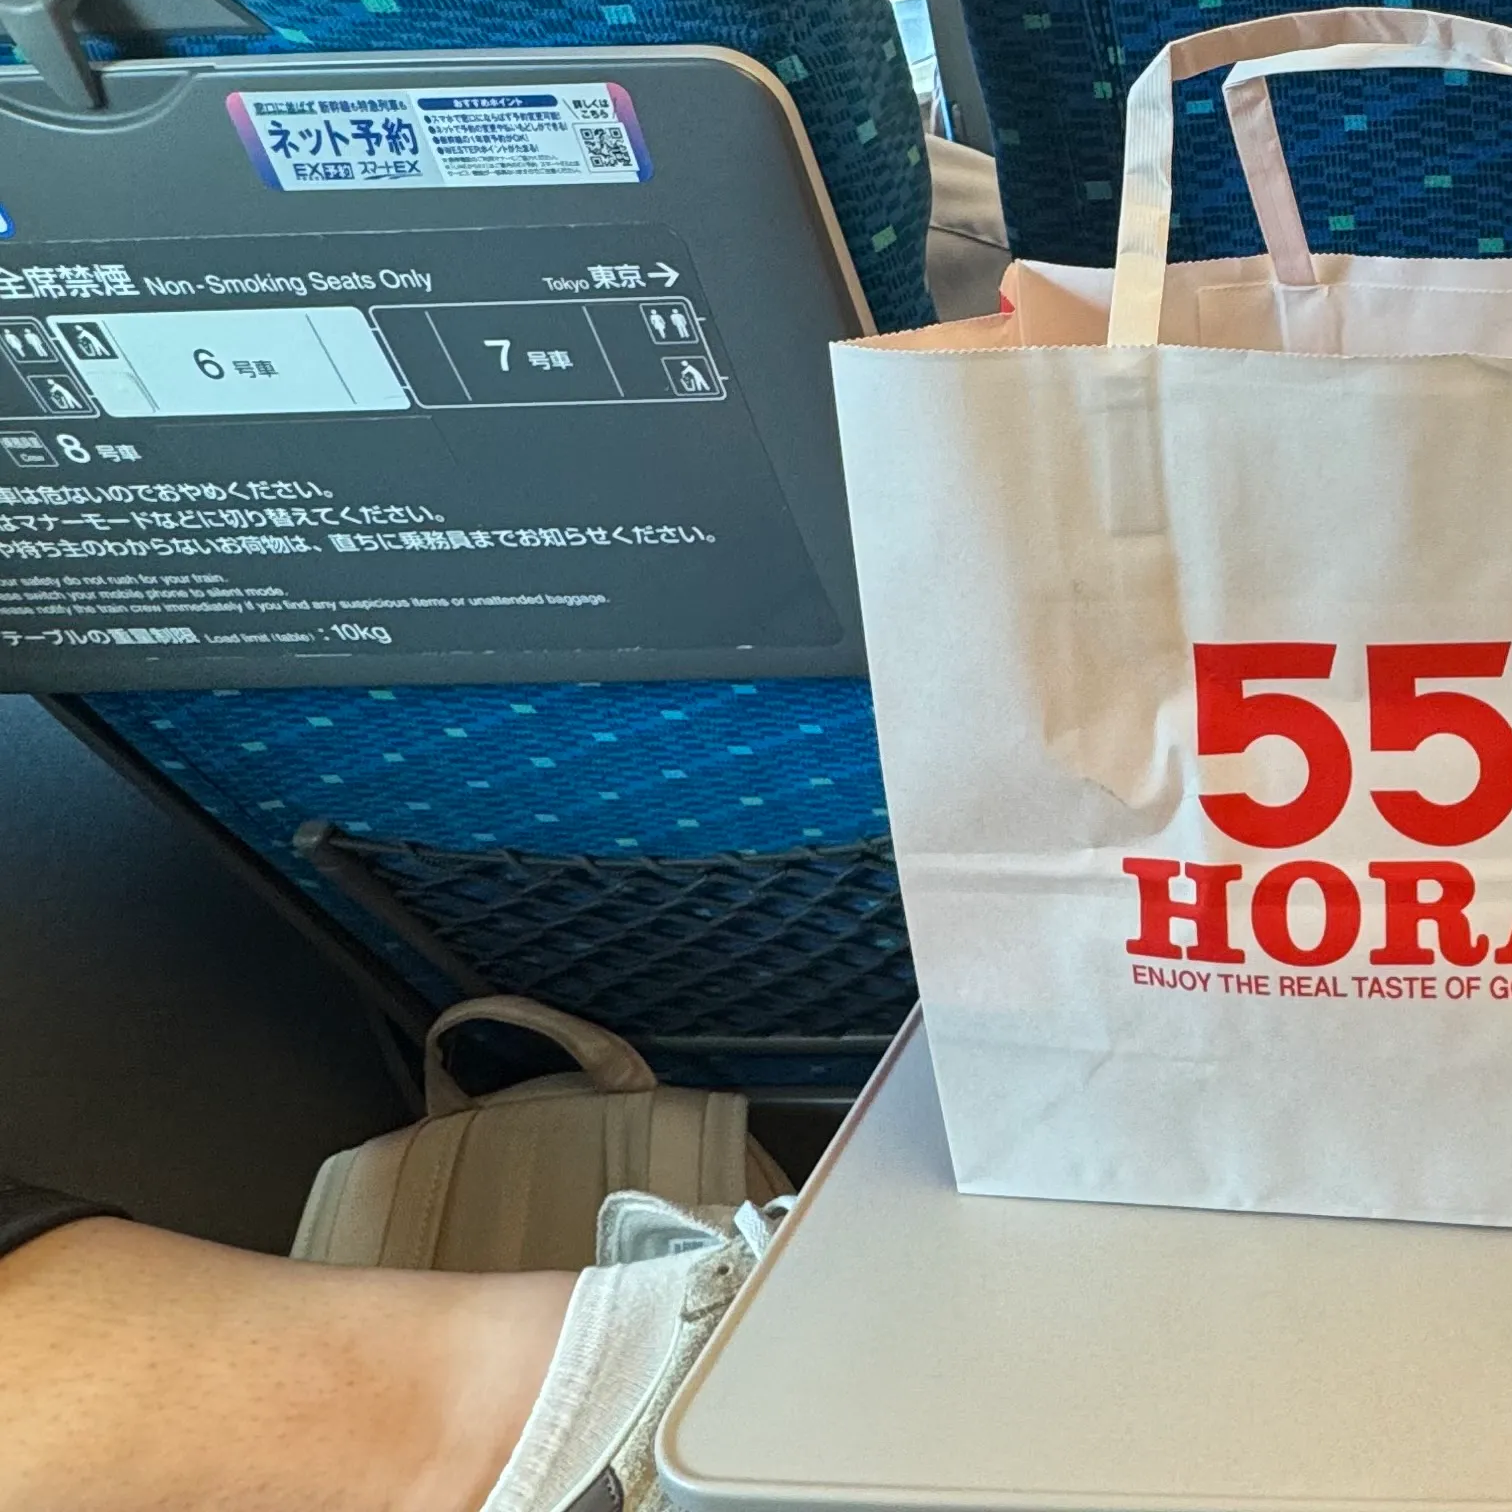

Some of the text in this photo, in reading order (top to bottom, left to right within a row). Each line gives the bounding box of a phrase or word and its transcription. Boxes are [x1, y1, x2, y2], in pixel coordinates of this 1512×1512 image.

[268, 118, 420, 159] ネット予約
[0, 264, 140, 300] 全席禁煙
[308, 271, 377, 292] Seats
[379, 268, 433, 293] Only
[542, 264, 647, 293] Tokyo 東京
[193, 348, 279, 381] 6 号車
[483, 339, 574, 372] 7 号車
[56, 433, 91, 464] 8
[1133, 965, 1211, 993] ENJOY
[1217, 974, 1271, 996] THE
[1279, 976, 1348, 998] REAL
[1351, 976, 1437, 1000] TASTE
[1445, 976, 1482, 1000] OF
